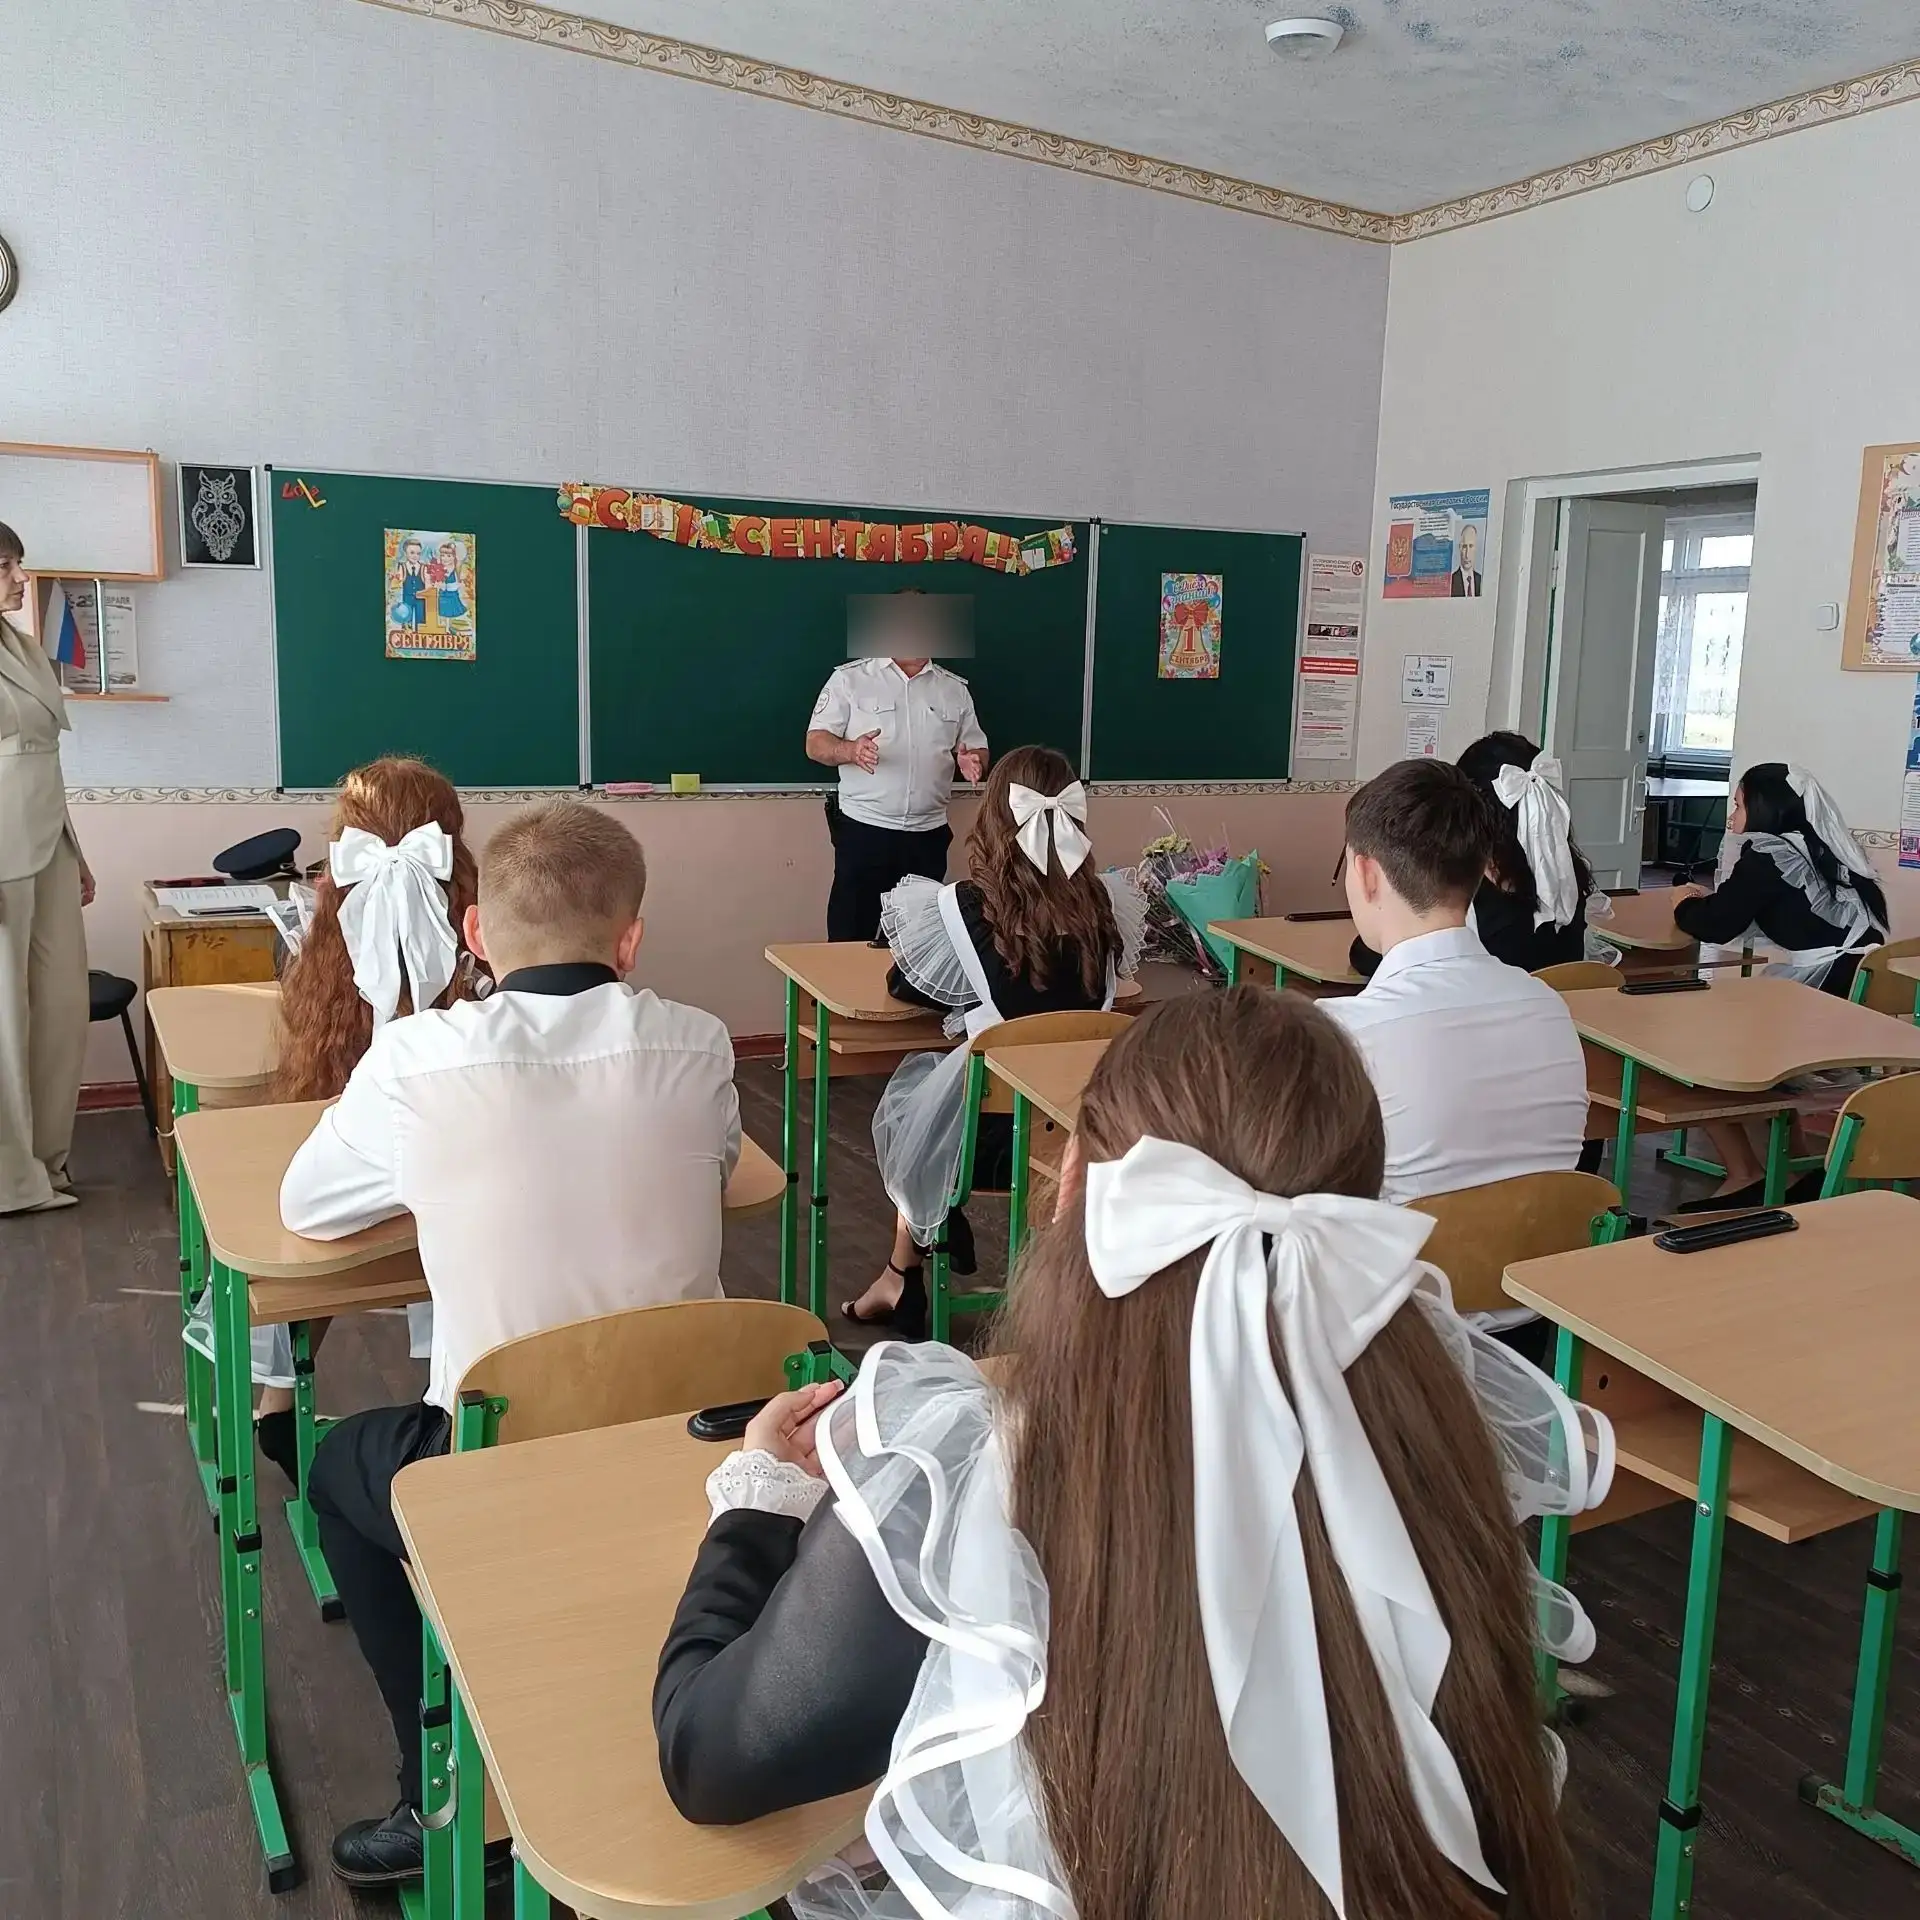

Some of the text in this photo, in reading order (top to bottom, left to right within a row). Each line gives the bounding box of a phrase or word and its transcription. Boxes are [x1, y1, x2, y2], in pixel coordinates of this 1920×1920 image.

[597, 487, 631, 530] С
[676, 504, 694, 544] 1
[415, 587, 447, 634] 1
[390, 631, 472, 649] СЕНТЯБРЯ
[1183, 626, 1196, 653] 1
